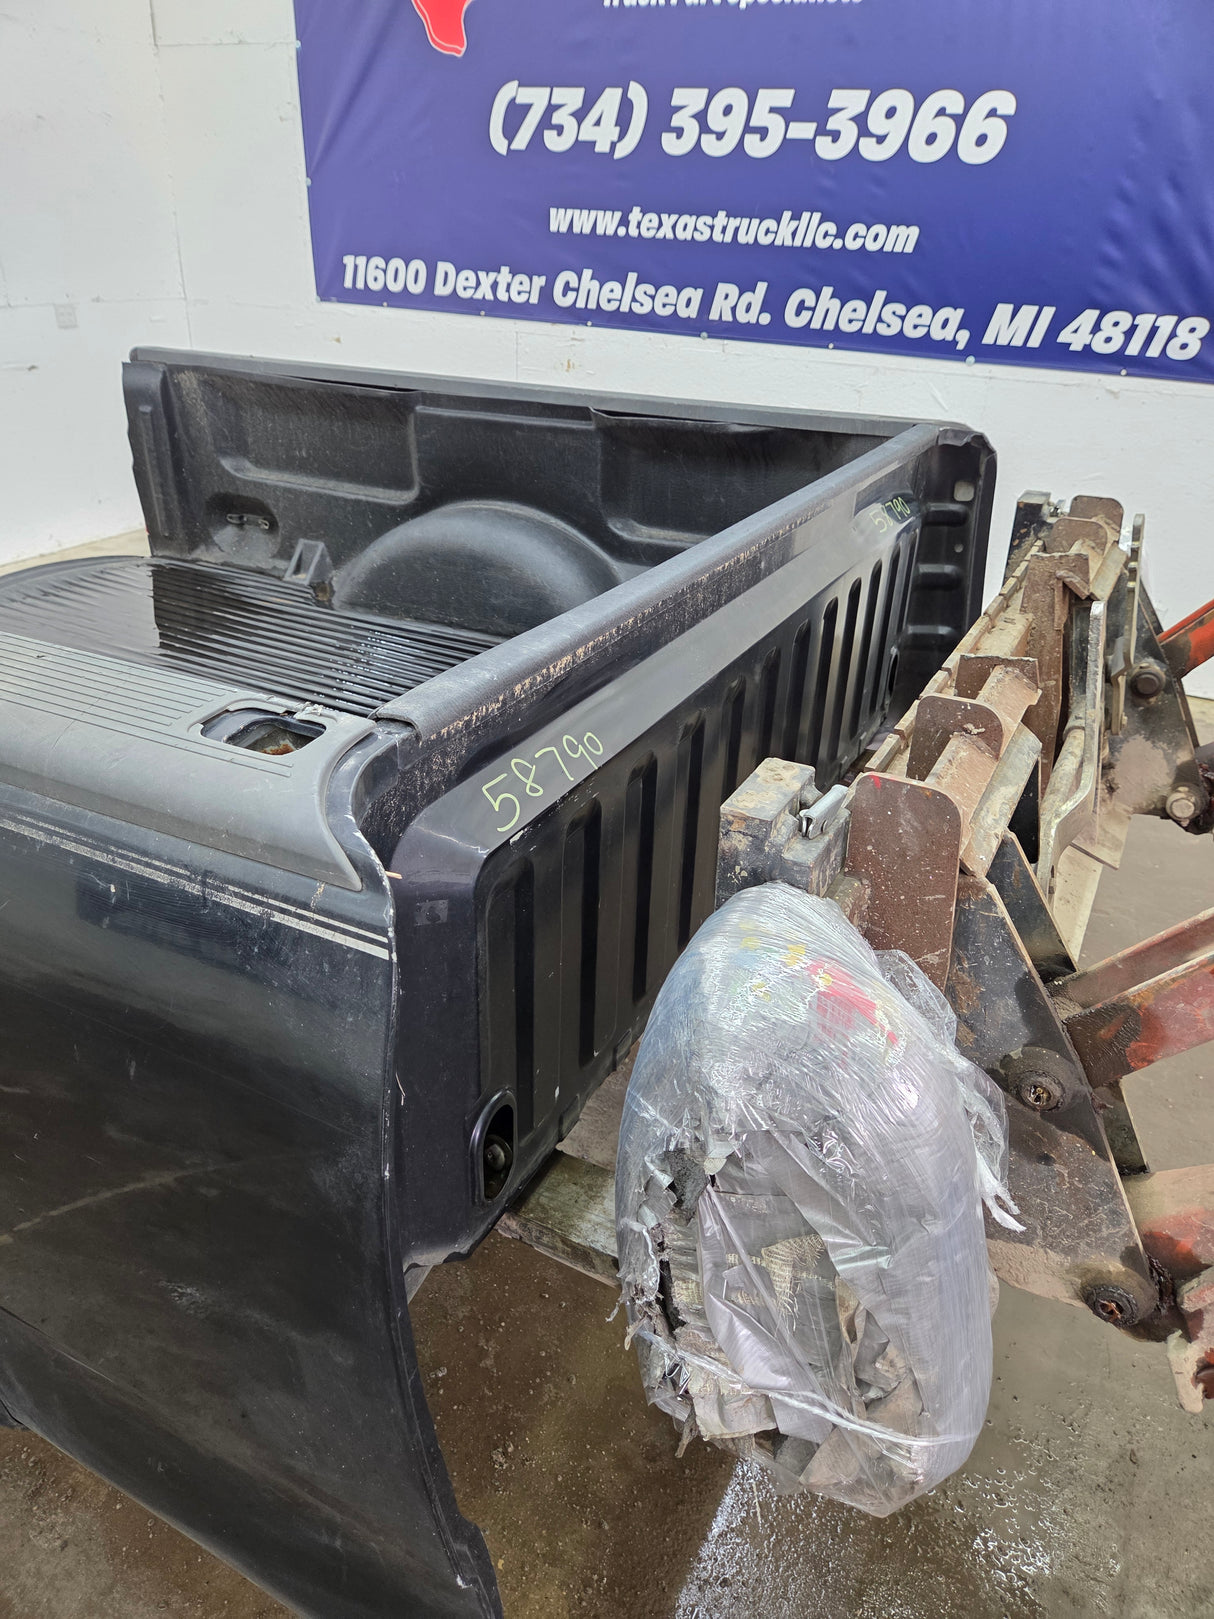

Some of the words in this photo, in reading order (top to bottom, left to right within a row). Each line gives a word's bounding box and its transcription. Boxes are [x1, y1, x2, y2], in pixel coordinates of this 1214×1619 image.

[489, 79, 649, 160] (734)
[661, 87, 1017, 165] 395-3966
[549, 205, 920, 254] www.texastruckllc.com
[342, 254, 428, 295] 11600
[433, 260, 547, 305] Dexter
[552, 268, 704, 319] Chelsea
[708, 281, 772, 326] Rd.
[784, 285, 971, 351] Chelsea,
[981, 302, 1057, 348] MI
[1056, 308, 1210, 361] 48118
[869, 496, 911, 533] 58790
[481, 732, 604, 832] 58790
